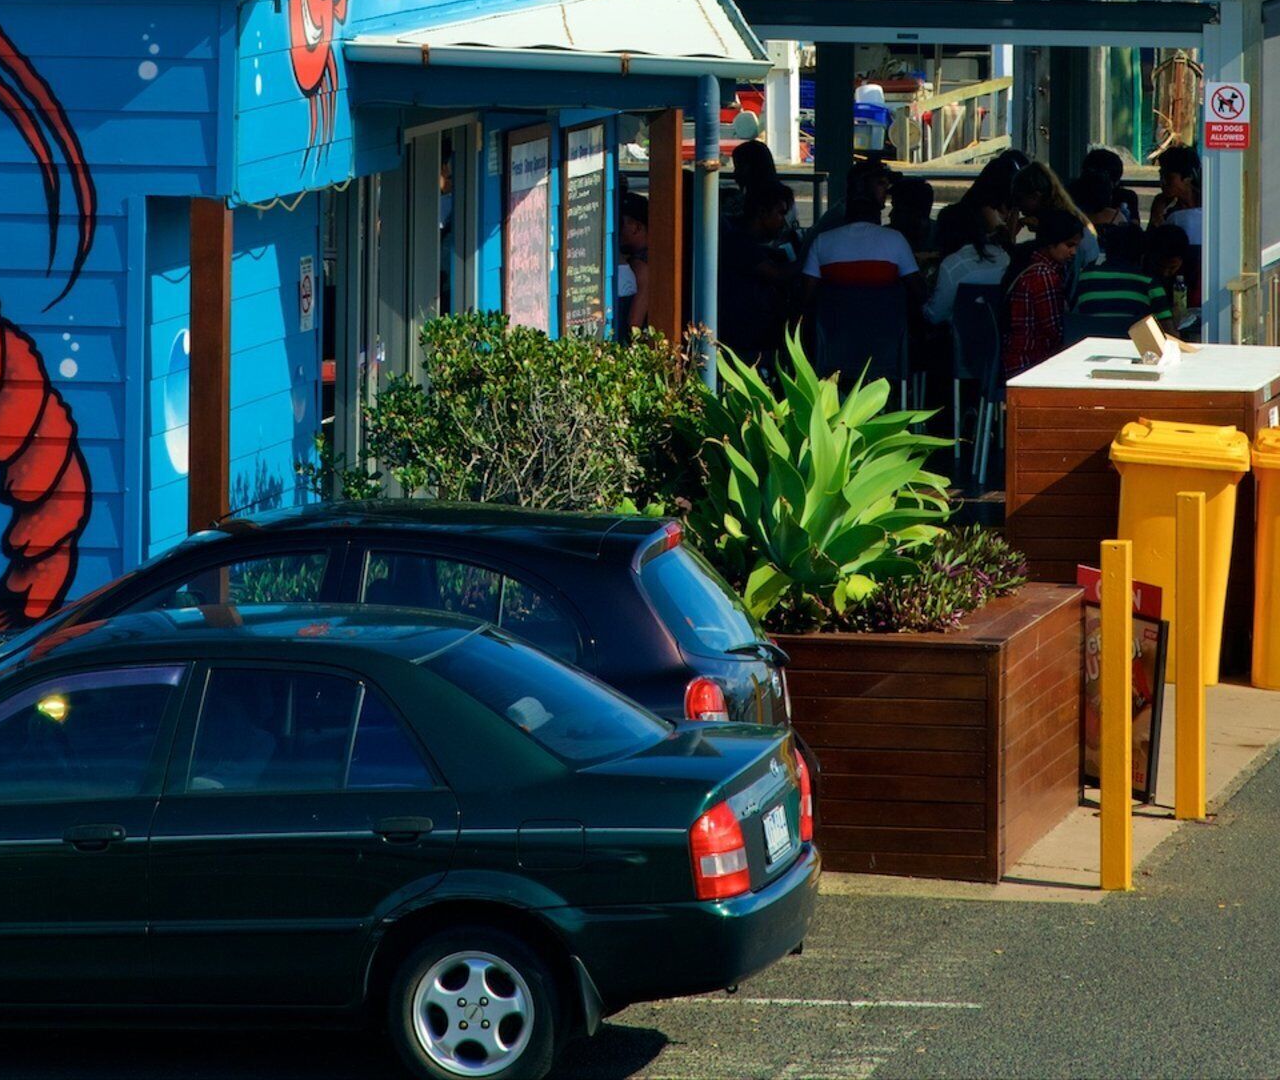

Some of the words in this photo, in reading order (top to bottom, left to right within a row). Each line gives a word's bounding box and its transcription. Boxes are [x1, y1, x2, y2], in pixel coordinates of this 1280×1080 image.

[1211, 124, 1223, 132] NO
[1224, 124, 1244, 133] DOGS
[1210, 133, 1245, 142] ALLOWED
